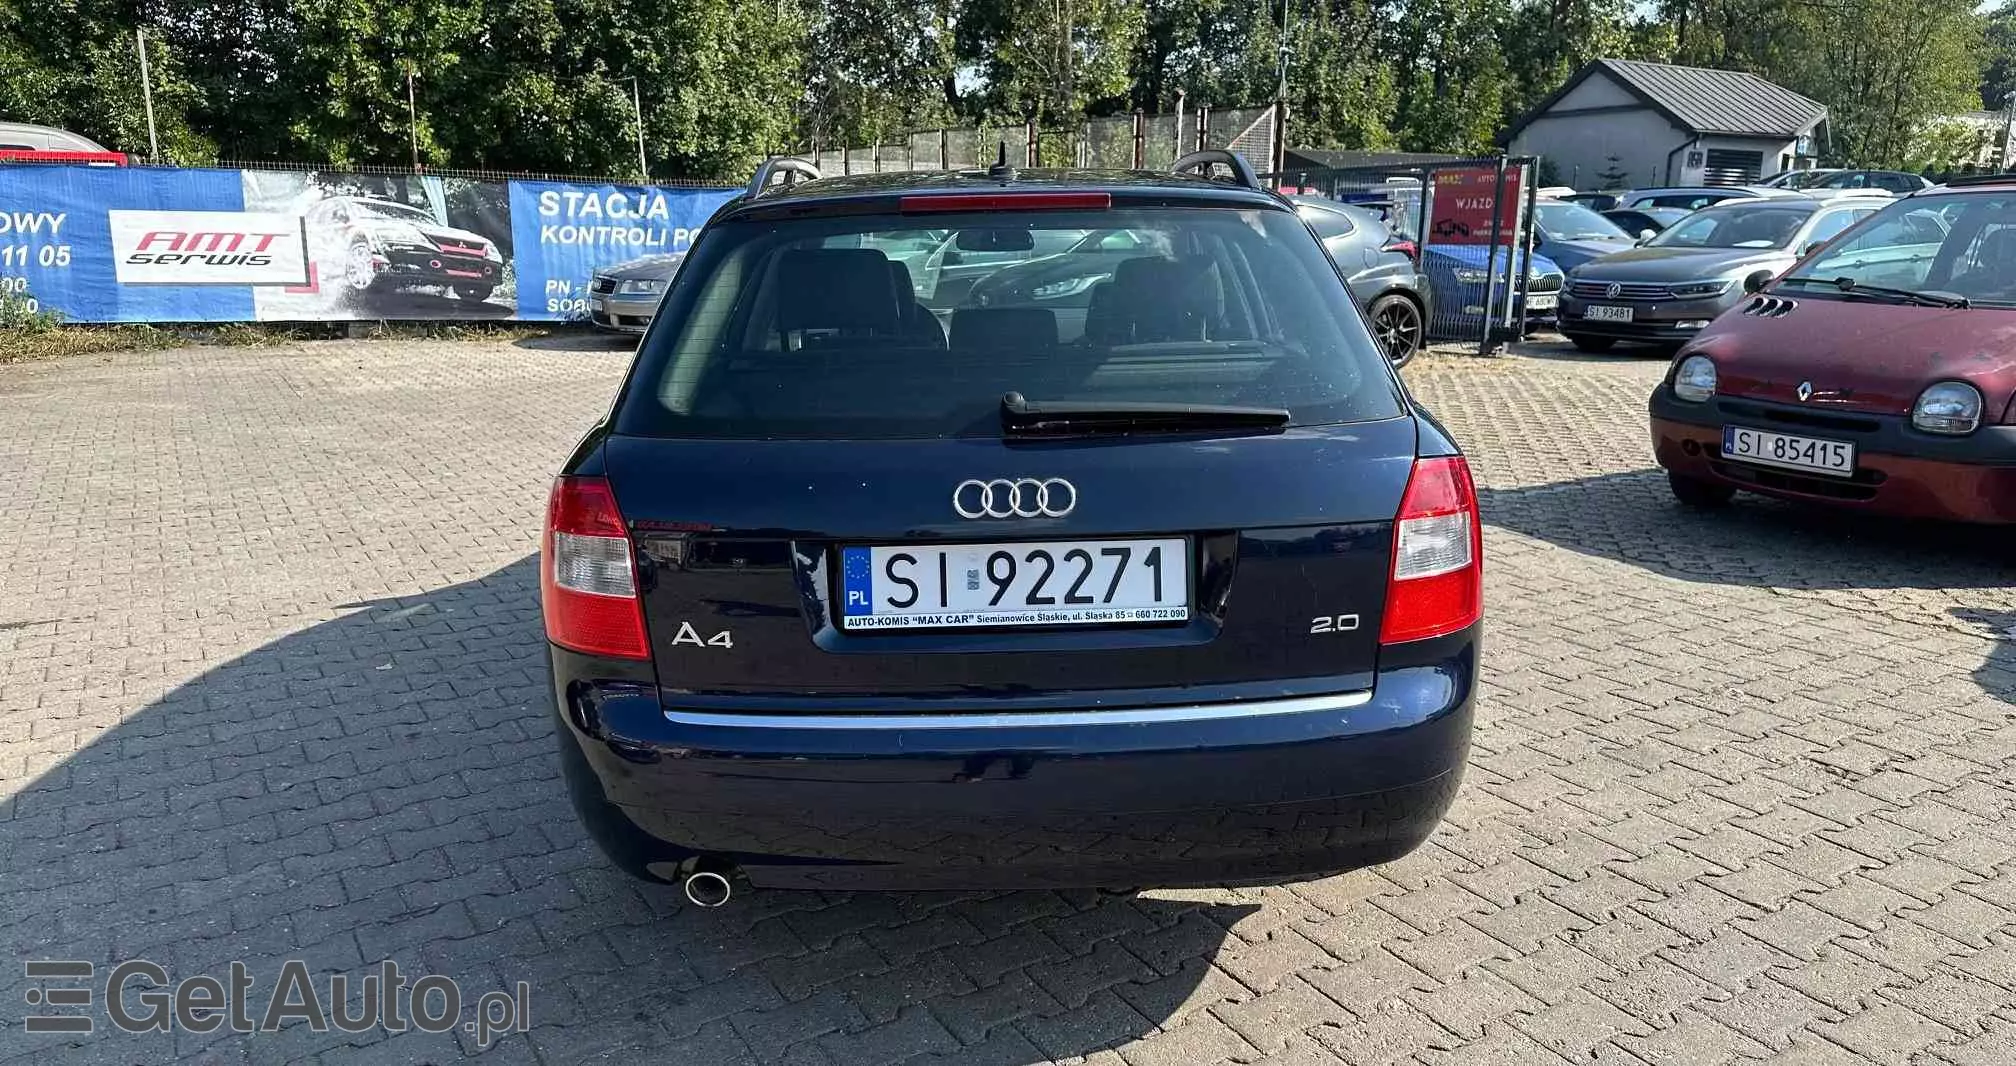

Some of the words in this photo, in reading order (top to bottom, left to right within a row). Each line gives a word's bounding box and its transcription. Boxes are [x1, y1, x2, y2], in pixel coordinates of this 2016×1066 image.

[538, 190, 669, 219] STACJA
[1456, 198, 1494, 209] WJAZD
[136, 231, 291, 252] AMT
[540, 225, 667, 246] KONTROLI
[39, 244, 72, 267] 05
[126, 252, 272, 266] serwis
[545, 279, 571, 297] PN
[1738, 432, 1761, 456] SI
[1774, 437, 1846, 467] 85415
[886, 552, 948, 608] SI
[986, 547, 1162, 606] 92271
[848, 590, 869, 606] PL
[848, 615, 910, 627] AUTO-KOMIS
[977, 612, 1035, 624] Siemianowice
[1115, 610, 1126, 619] 85
[1135, 610, 1151, 619] 660
[1152, 609, 1168, 618] 722
[1170, 609, 1186, 618] 090
[1310, 614, 1359, 633] 2.0
[672, 621, 733, 648] A4
